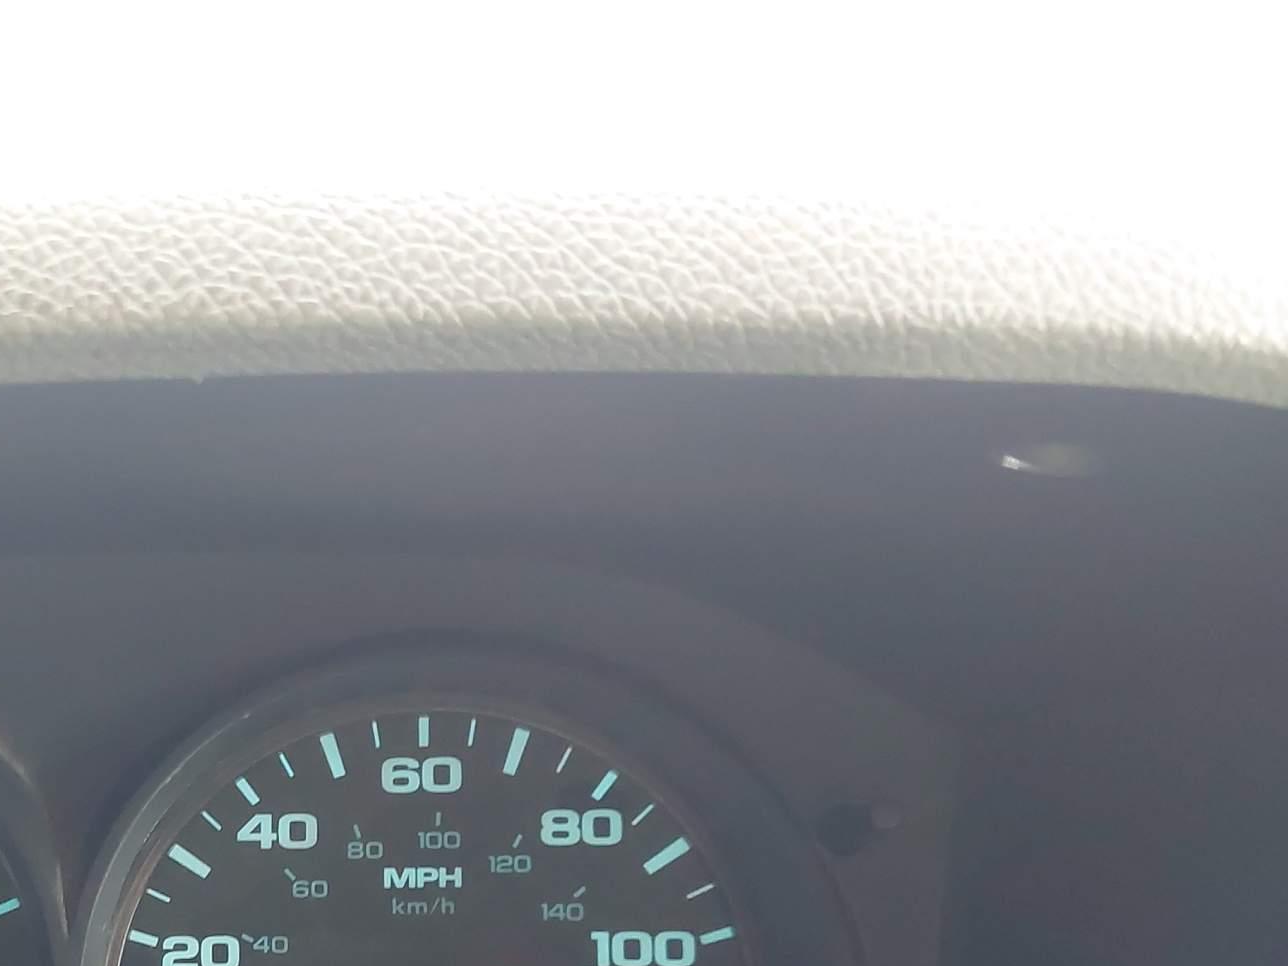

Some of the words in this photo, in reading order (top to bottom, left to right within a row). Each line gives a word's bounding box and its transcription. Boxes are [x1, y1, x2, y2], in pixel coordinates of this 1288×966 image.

[381, 757, 461, 792] 60
[237, 813, 318, 849] 40
[540, 809, 622, 845] 80
[417, 831, 461, 849] 100
[346, 841, 383, 859] 80
[488, 855, 532, 873] 120
[383, 867, 462, 888] MPH
[292, 880, 328, 898] 60
[391, 897, 455, 916] km/h
[540, 903, 584, 921] 140
[252, 936, 288, 954] 40
